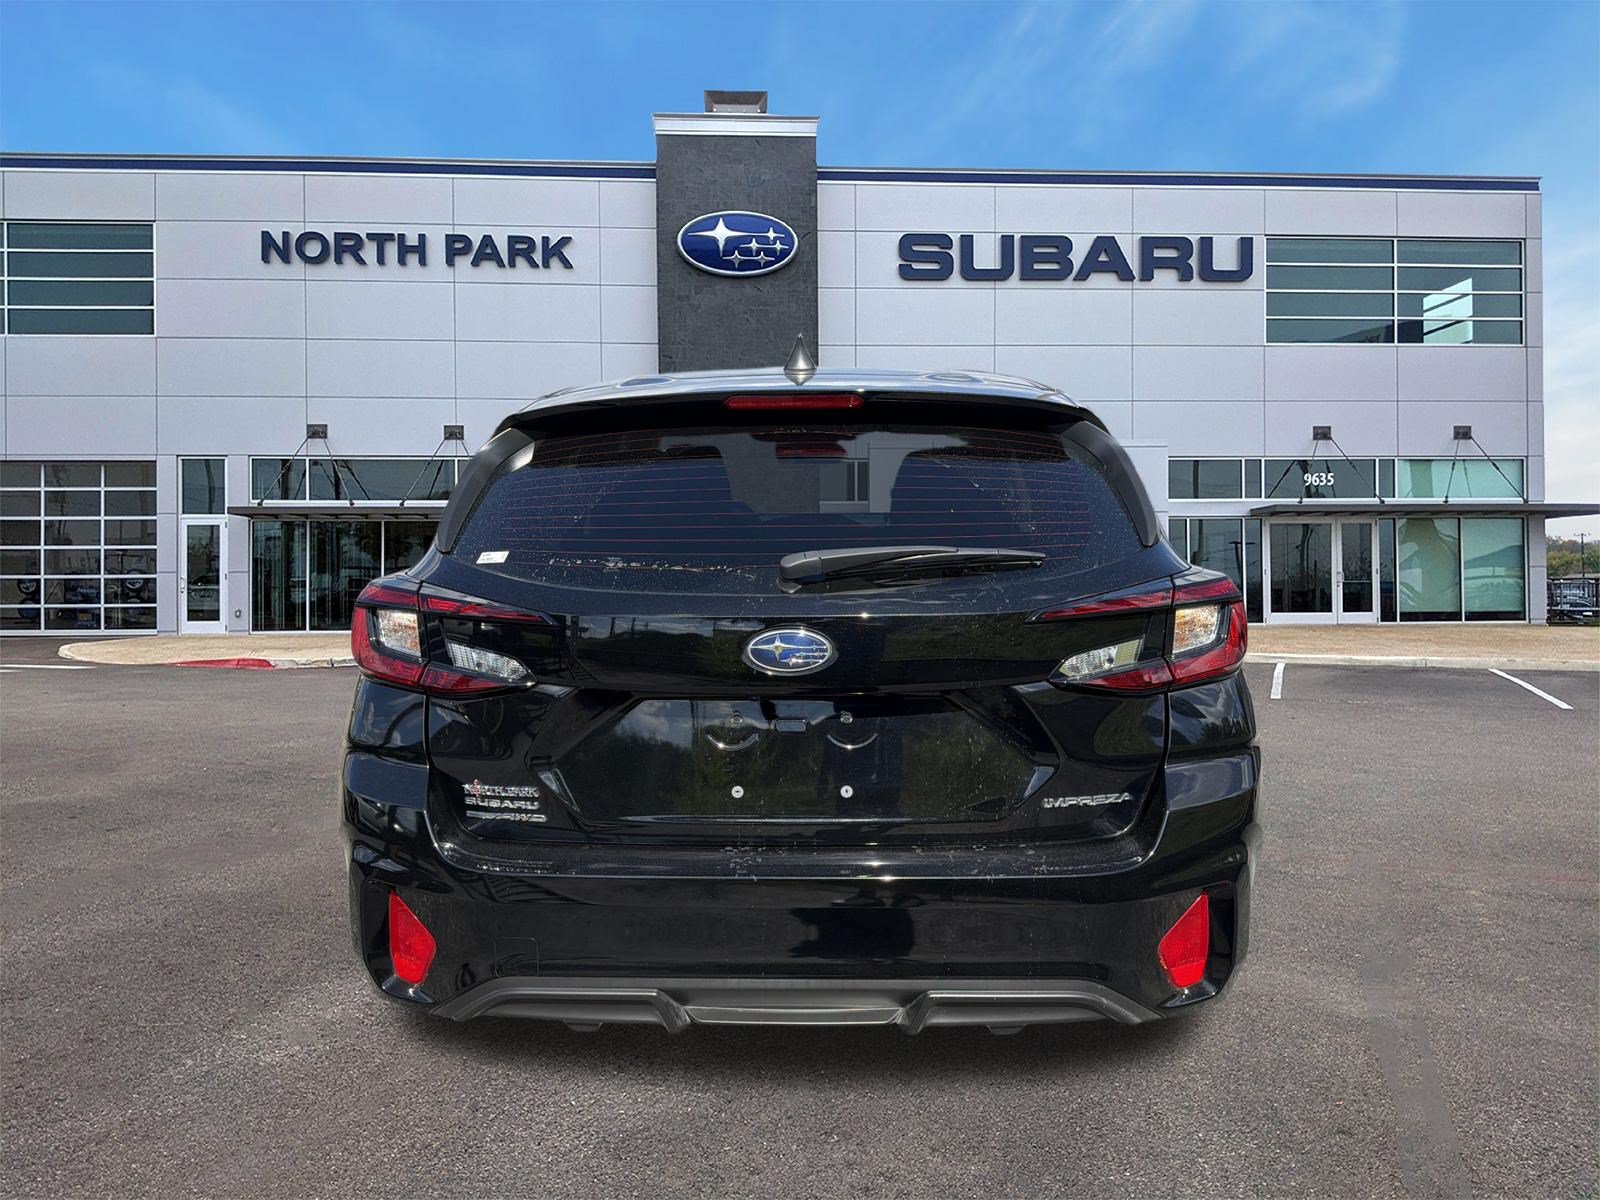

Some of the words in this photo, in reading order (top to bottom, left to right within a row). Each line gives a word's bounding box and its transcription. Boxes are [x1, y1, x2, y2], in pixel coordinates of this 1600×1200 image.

[261, 230, 428, 266] NORTH
[445, 233, 574, 269] PARK
[898, 233, 1254, 282] SUBARU
[1303, 472, 1335, 486] 9635
[465, 797, 540, 810] SUBARU
[1043, 792, 1132, 809] IMPREZA
